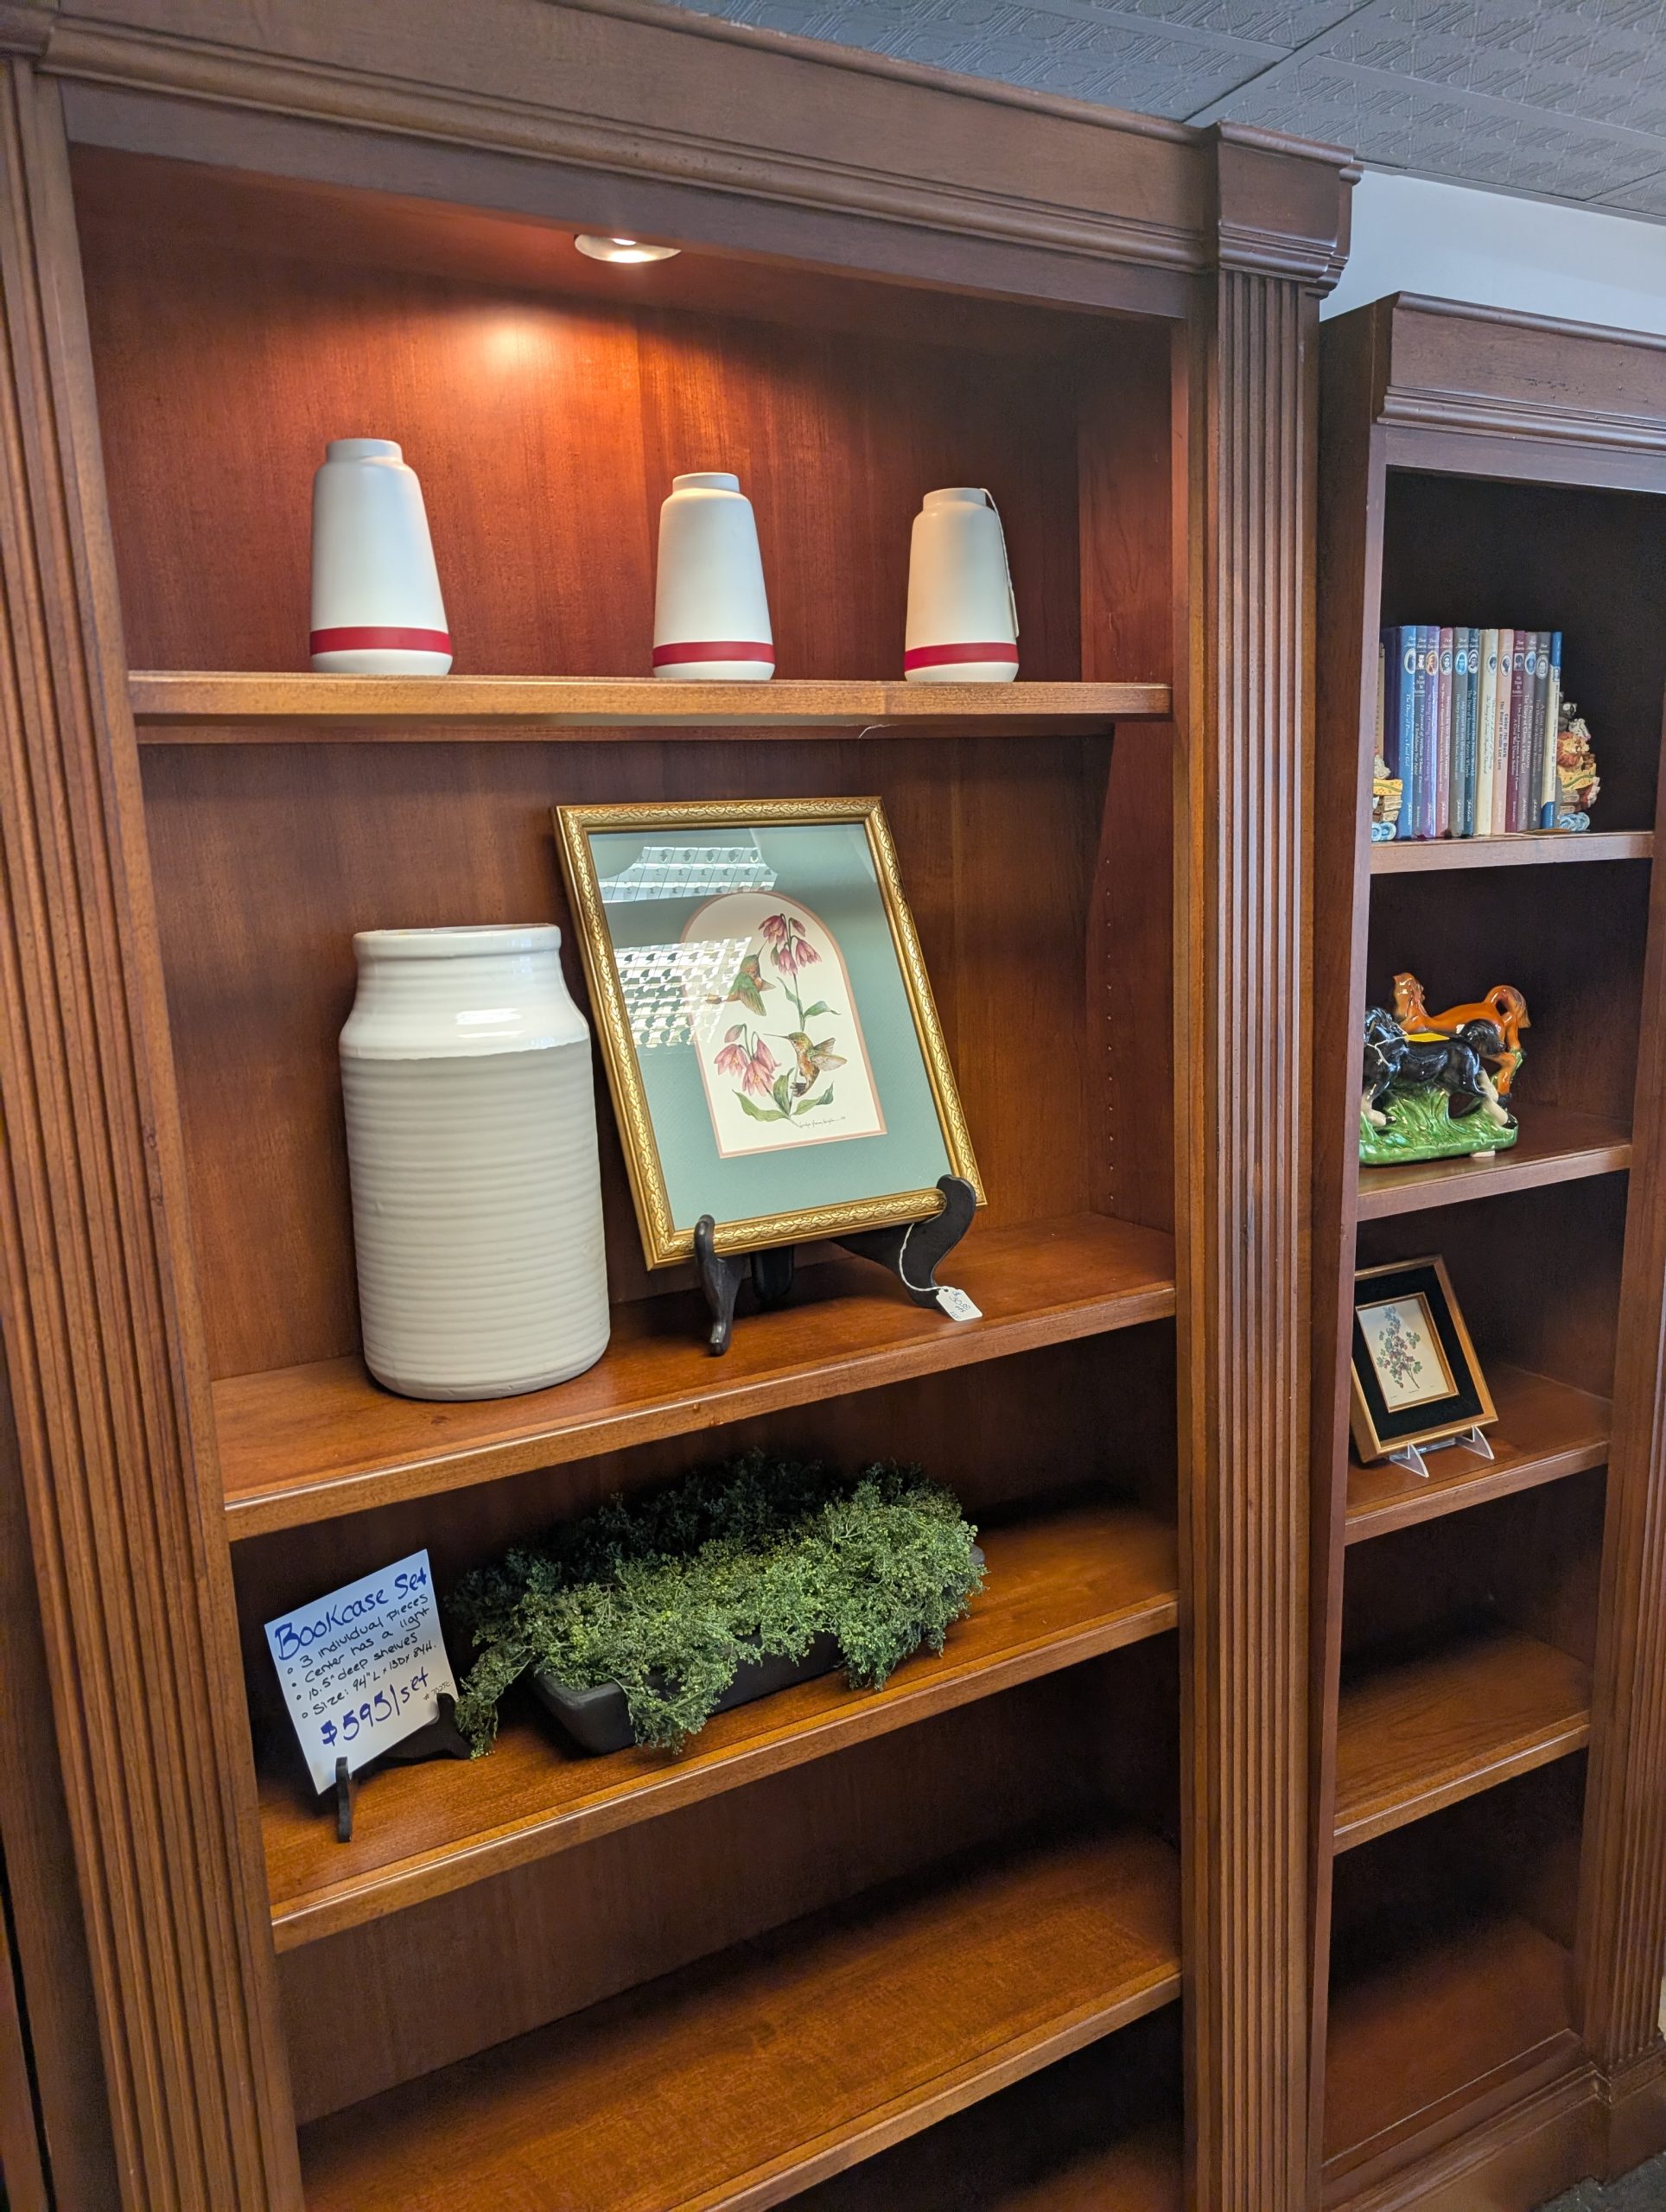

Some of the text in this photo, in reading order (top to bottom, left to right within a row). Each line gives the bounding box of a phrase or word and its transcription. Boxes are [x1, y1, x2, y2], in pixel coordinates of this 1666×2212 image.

[394, 1567, 427, 1599] Set
[299, 1593, 429, 1669] 3 individual pieces
[304, 1607, 430, 1683] Center has a light
[337, 1659, 368, 1680] deep
[373, 1632, 418, 1661] shelves
[313, 1689, 349, 1715] Size:
